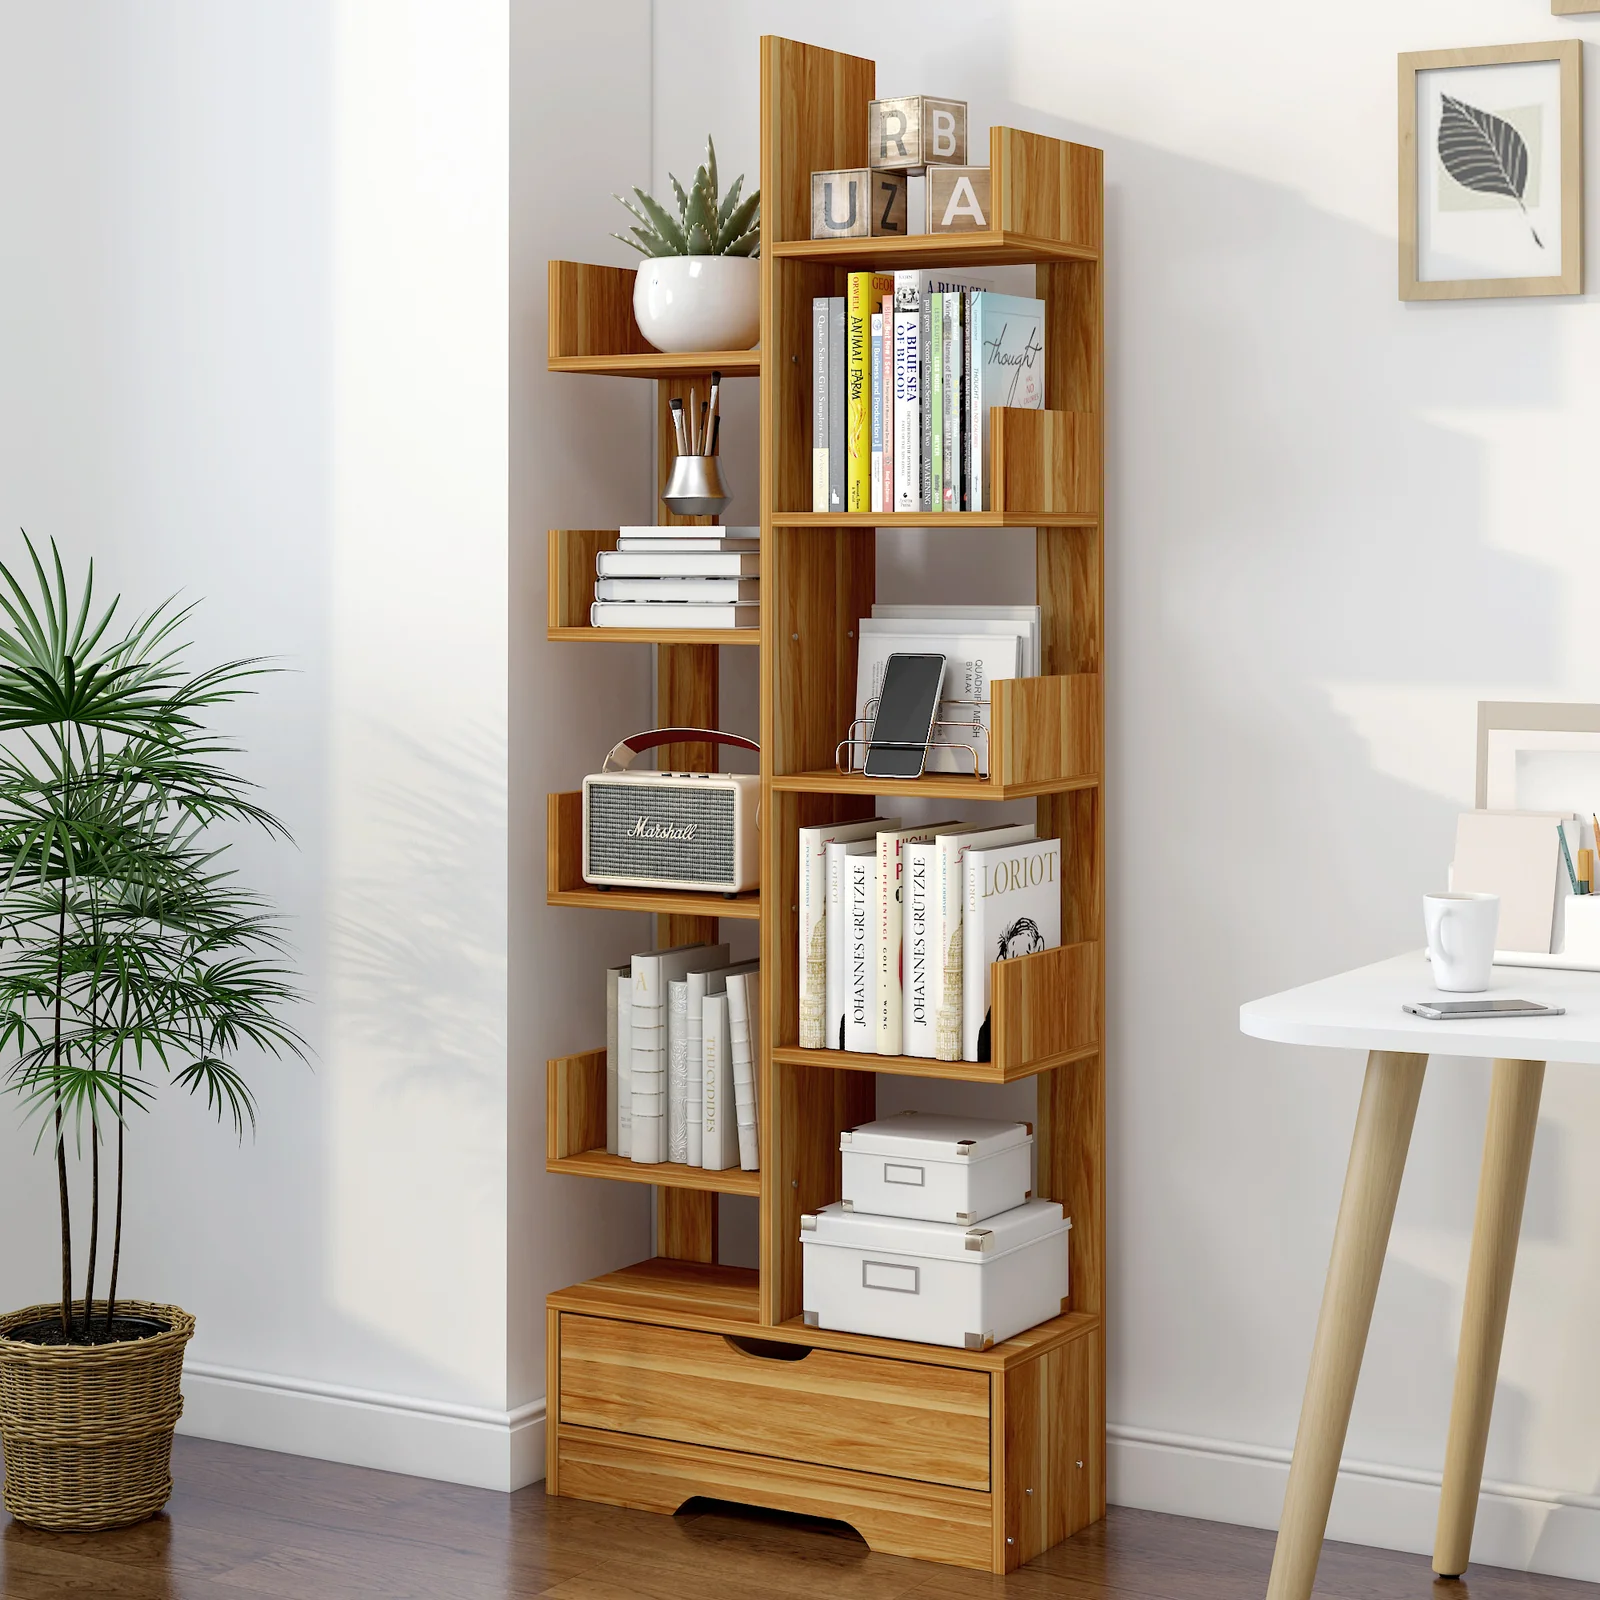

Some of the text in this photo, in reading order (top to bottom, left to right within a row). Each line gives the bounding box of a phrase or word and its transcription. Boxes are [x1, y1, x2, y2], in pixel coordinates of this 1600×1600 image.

[880, 110, 908, 159] R
[933, 109, 957, 157] B
[824, 181, 857, 230] U
[881, 182, 898, 231] Z
[941, 176, 987, 226] A
[852, 276, 860, 312] ORWELL
[818, 315, 826, 345] Quaker
[818, 347, 826, 373] School
[851, 316, 863, 400] ANIMAL FARM
[873, 348, 881, 377] Business
[896, 325, 905, 399] OF BLOOD
[907, 322, 917, 402] A BLUE SEA
[945, 365, 951, 373] of
[818, 376, 826, 393] Girl
[818, 396, 826, 431] Samplers
[873, 398, 881, 438] Production
[965, 661, 973, 673] BY
[627, 816, 698, 841] Marshall
[911, 857, 926, 936] GRÜTZKE
[982, 852, 1058, 898] LORIOT
[852, 865, 866, 1027] JOHANNES GRÜTZKE
[636, 973, 648, 991] A
[913, 938, 927, 1027] JOHANNES
[706, 1037, 716, 1133] THUCYDIDES
